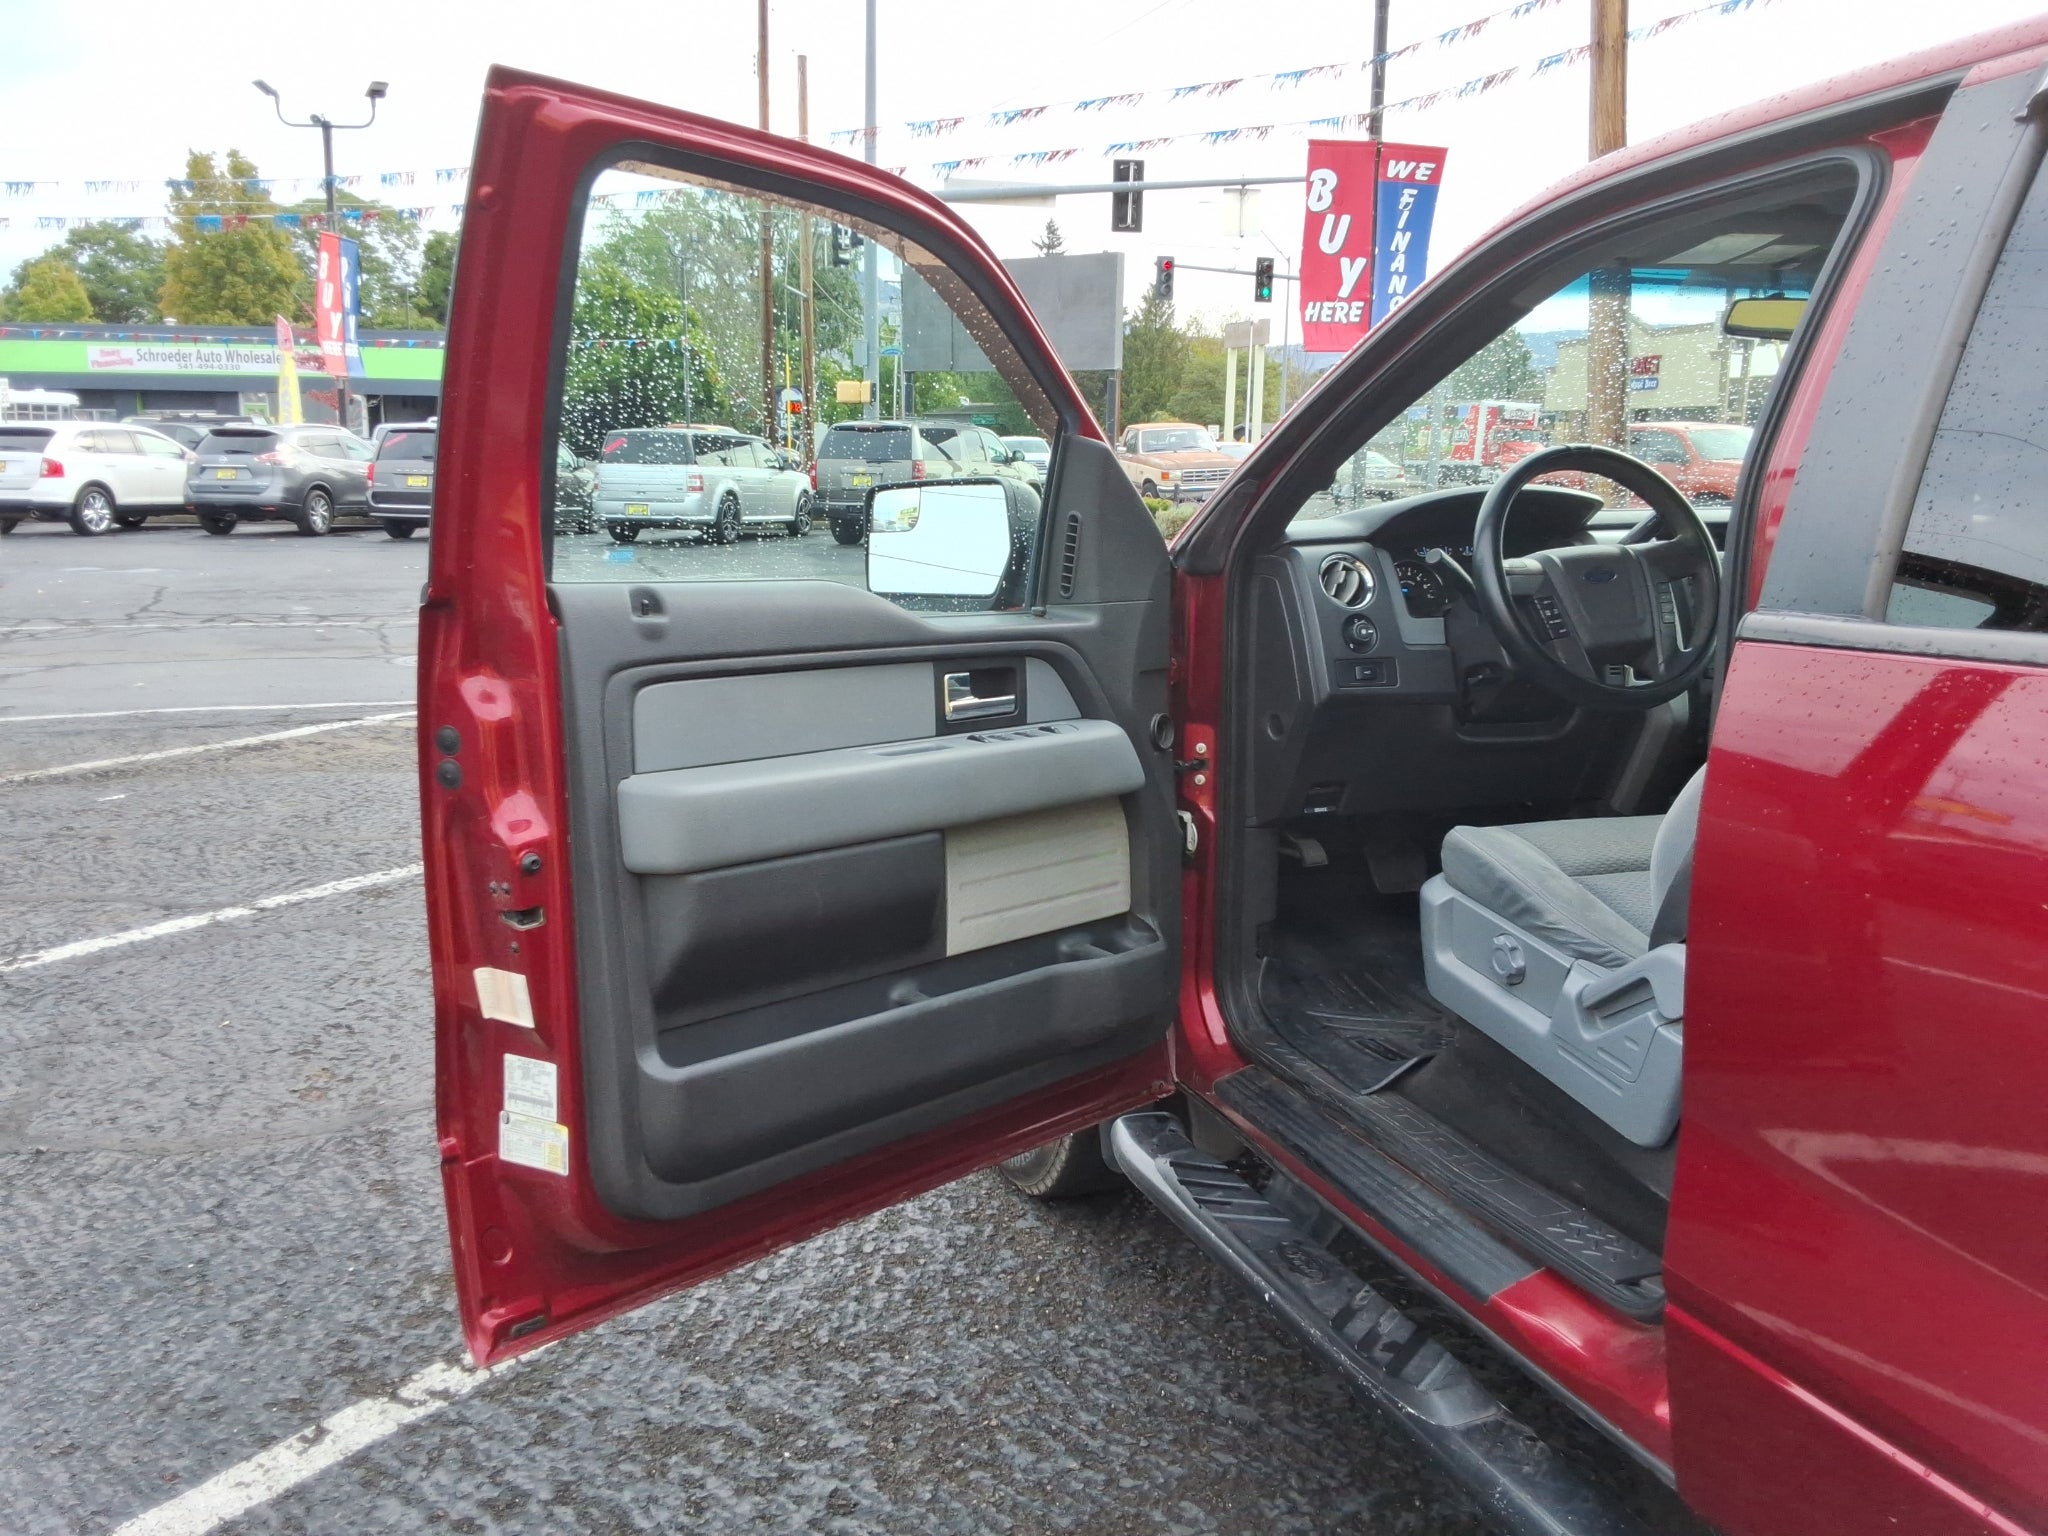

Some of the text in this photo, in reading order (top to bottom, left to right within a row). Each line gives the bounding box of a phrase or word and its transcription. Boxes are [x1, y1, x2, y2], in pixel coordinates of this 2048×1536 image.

[1386, 160, 1436, 182] WE
[1307, 168, 1367, 299] BUY
[319, 251, 343, 340] BUY
[1304, 301, 1365, 324] HERE
[136, 348, 193, 363] Schroeder
[196, 349, 222, 363] Auto
